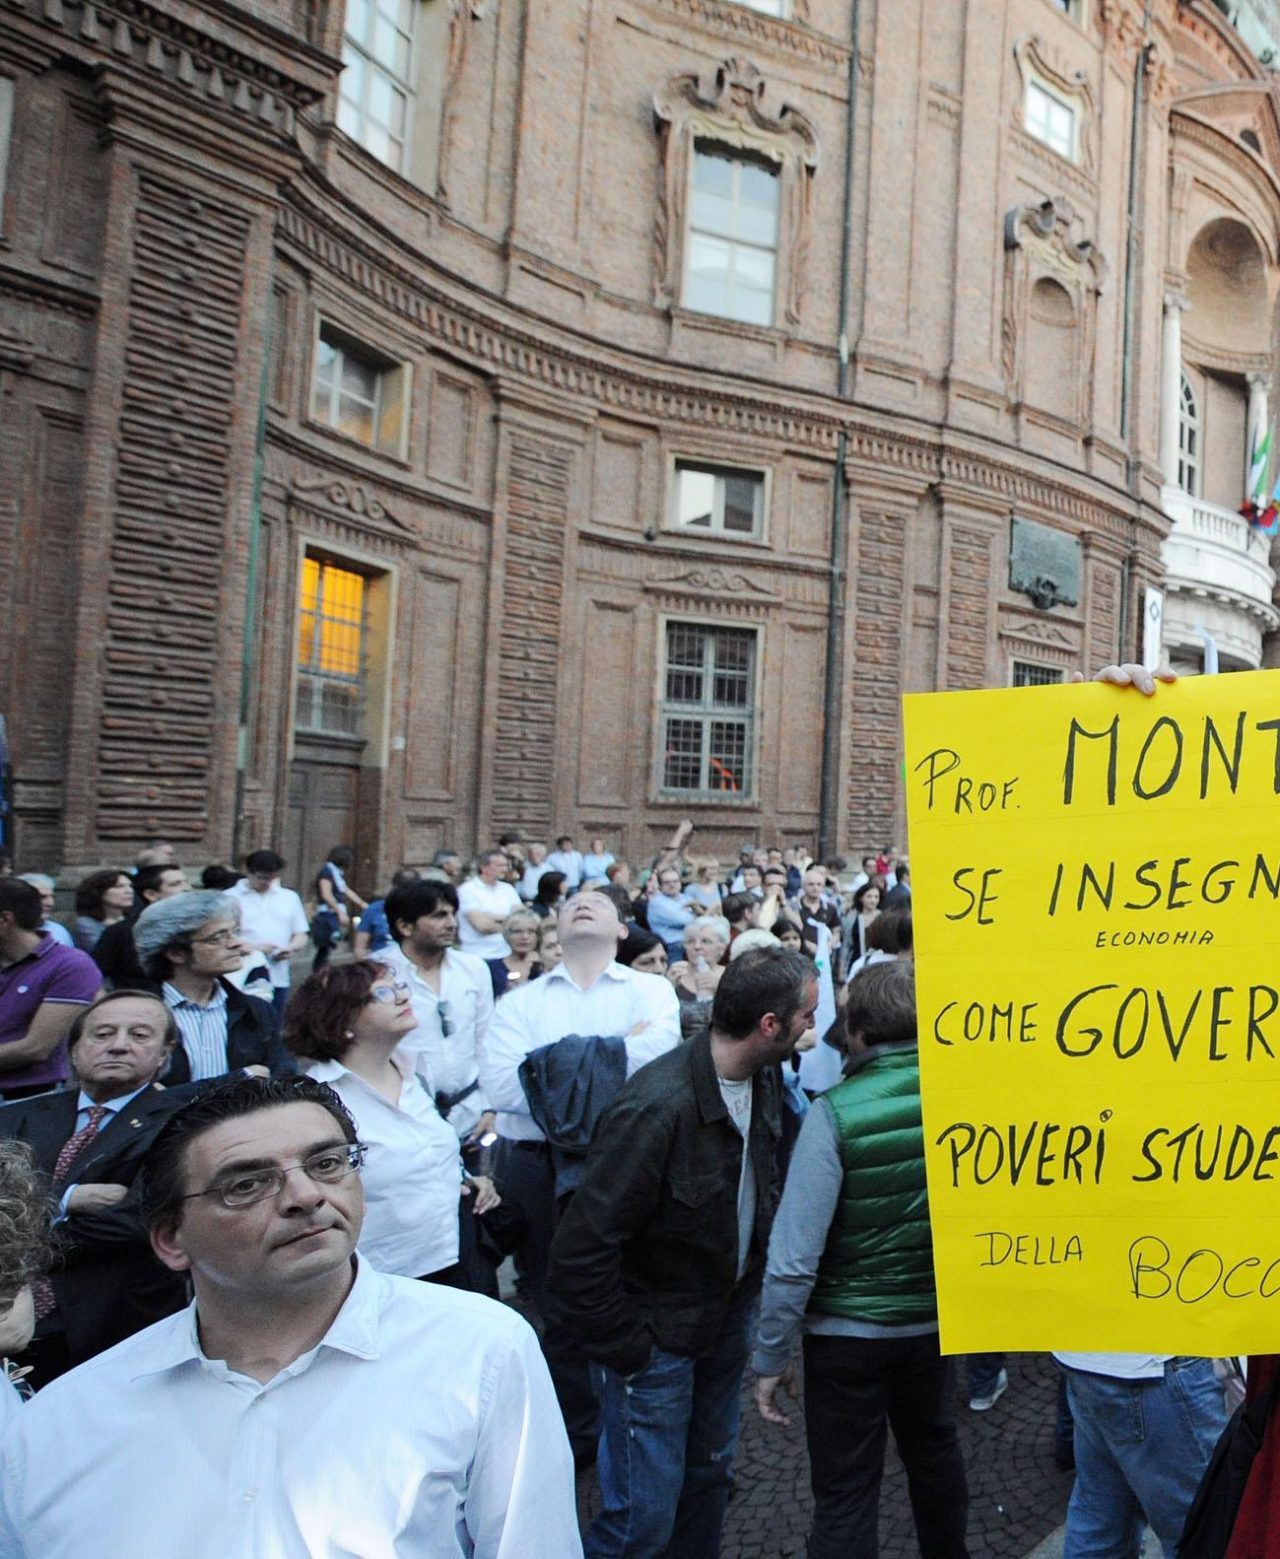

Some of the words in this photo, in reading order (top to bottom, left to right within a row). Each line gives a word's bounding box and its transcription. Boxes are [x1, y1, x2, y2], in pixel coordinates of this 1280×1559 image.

[945, 867, 1003, 926] SE
[1095, 929, 1215, 949] ECONOMIA
[933, 1001, 1039, 1046] COME
[973, 1231, 1084, 1268] DELLA
